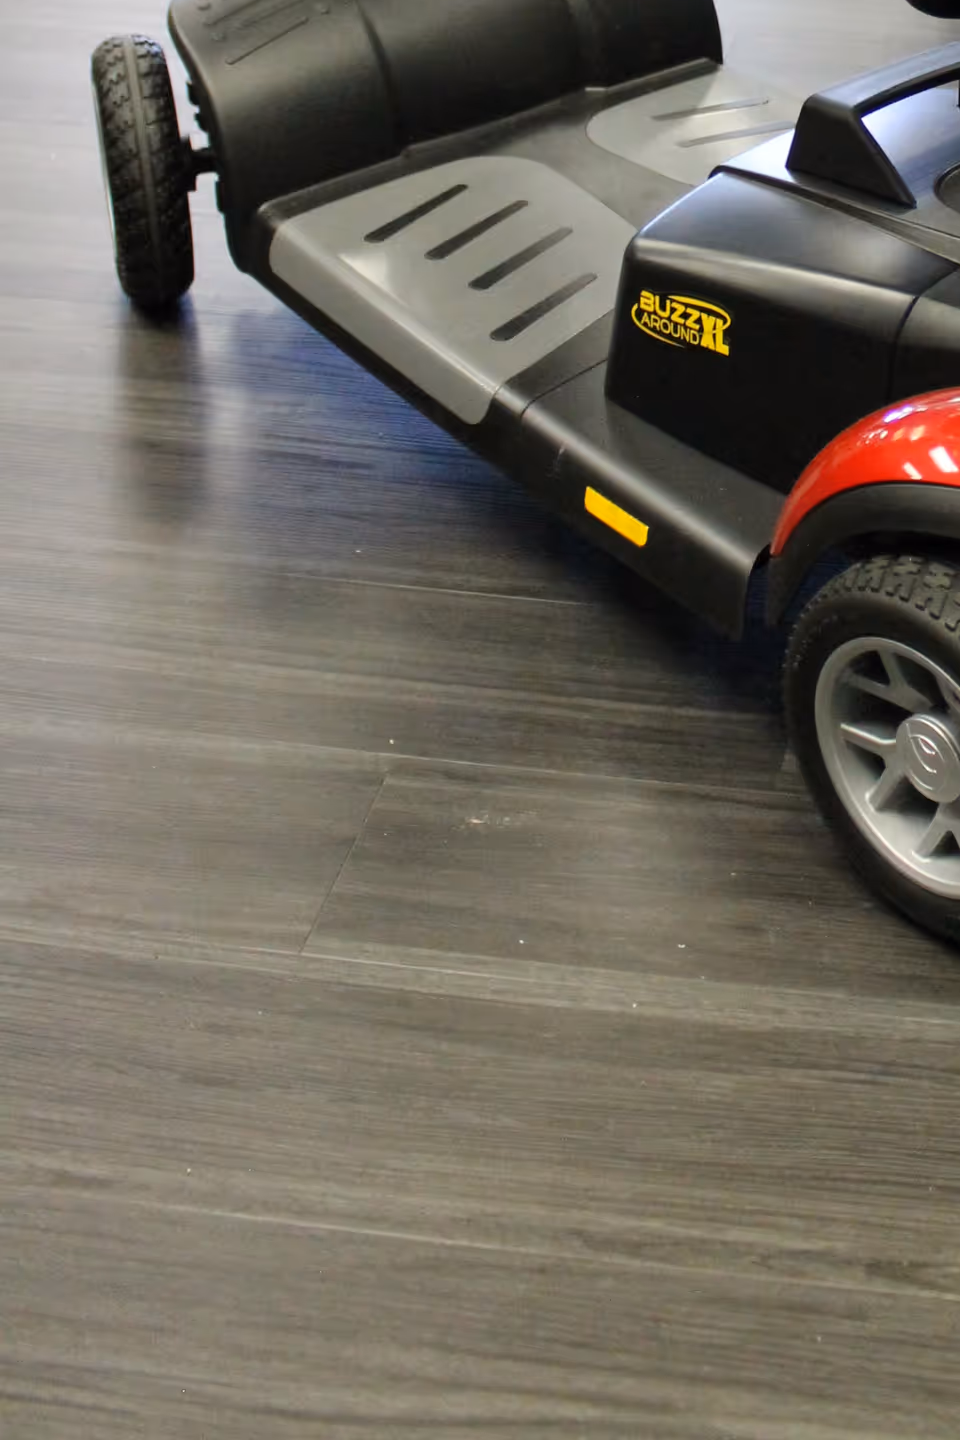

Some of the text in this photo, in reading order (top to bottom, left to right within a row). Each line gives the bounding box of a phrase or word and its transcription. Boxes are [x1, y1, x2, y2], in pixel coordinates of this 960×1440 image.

[640, 290, 701, 330] BUZZ
[640, 312, 730, 356] AROUND XL
